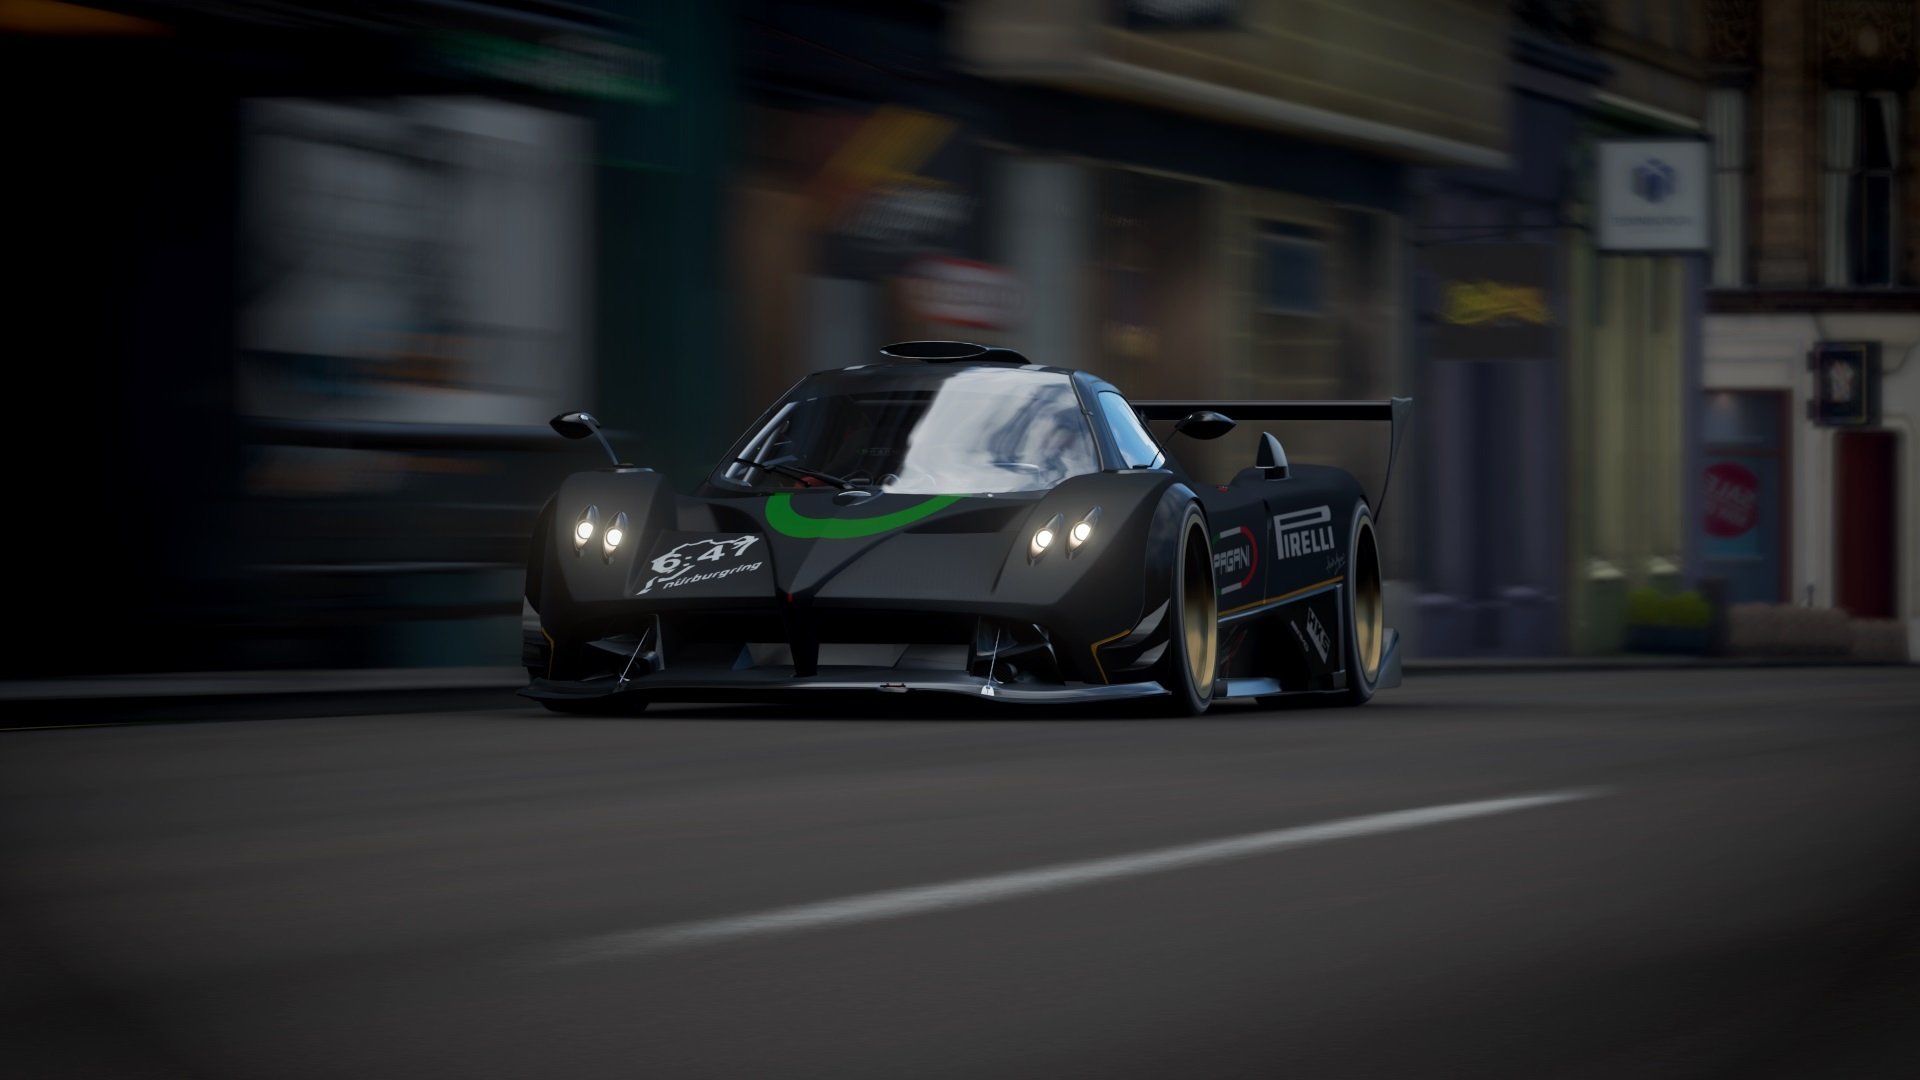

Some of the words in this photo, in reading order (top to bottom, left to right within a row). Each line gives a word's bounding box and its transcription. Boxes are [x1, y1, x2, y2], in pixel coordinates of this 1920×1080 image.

[1273, 505, 1335, 560] PIRELLI
[652, 535, 759, 574] 6:47
[1213, 544, 1250, 576] PAGANI
[662, 562, 763, 590] nürburgring
